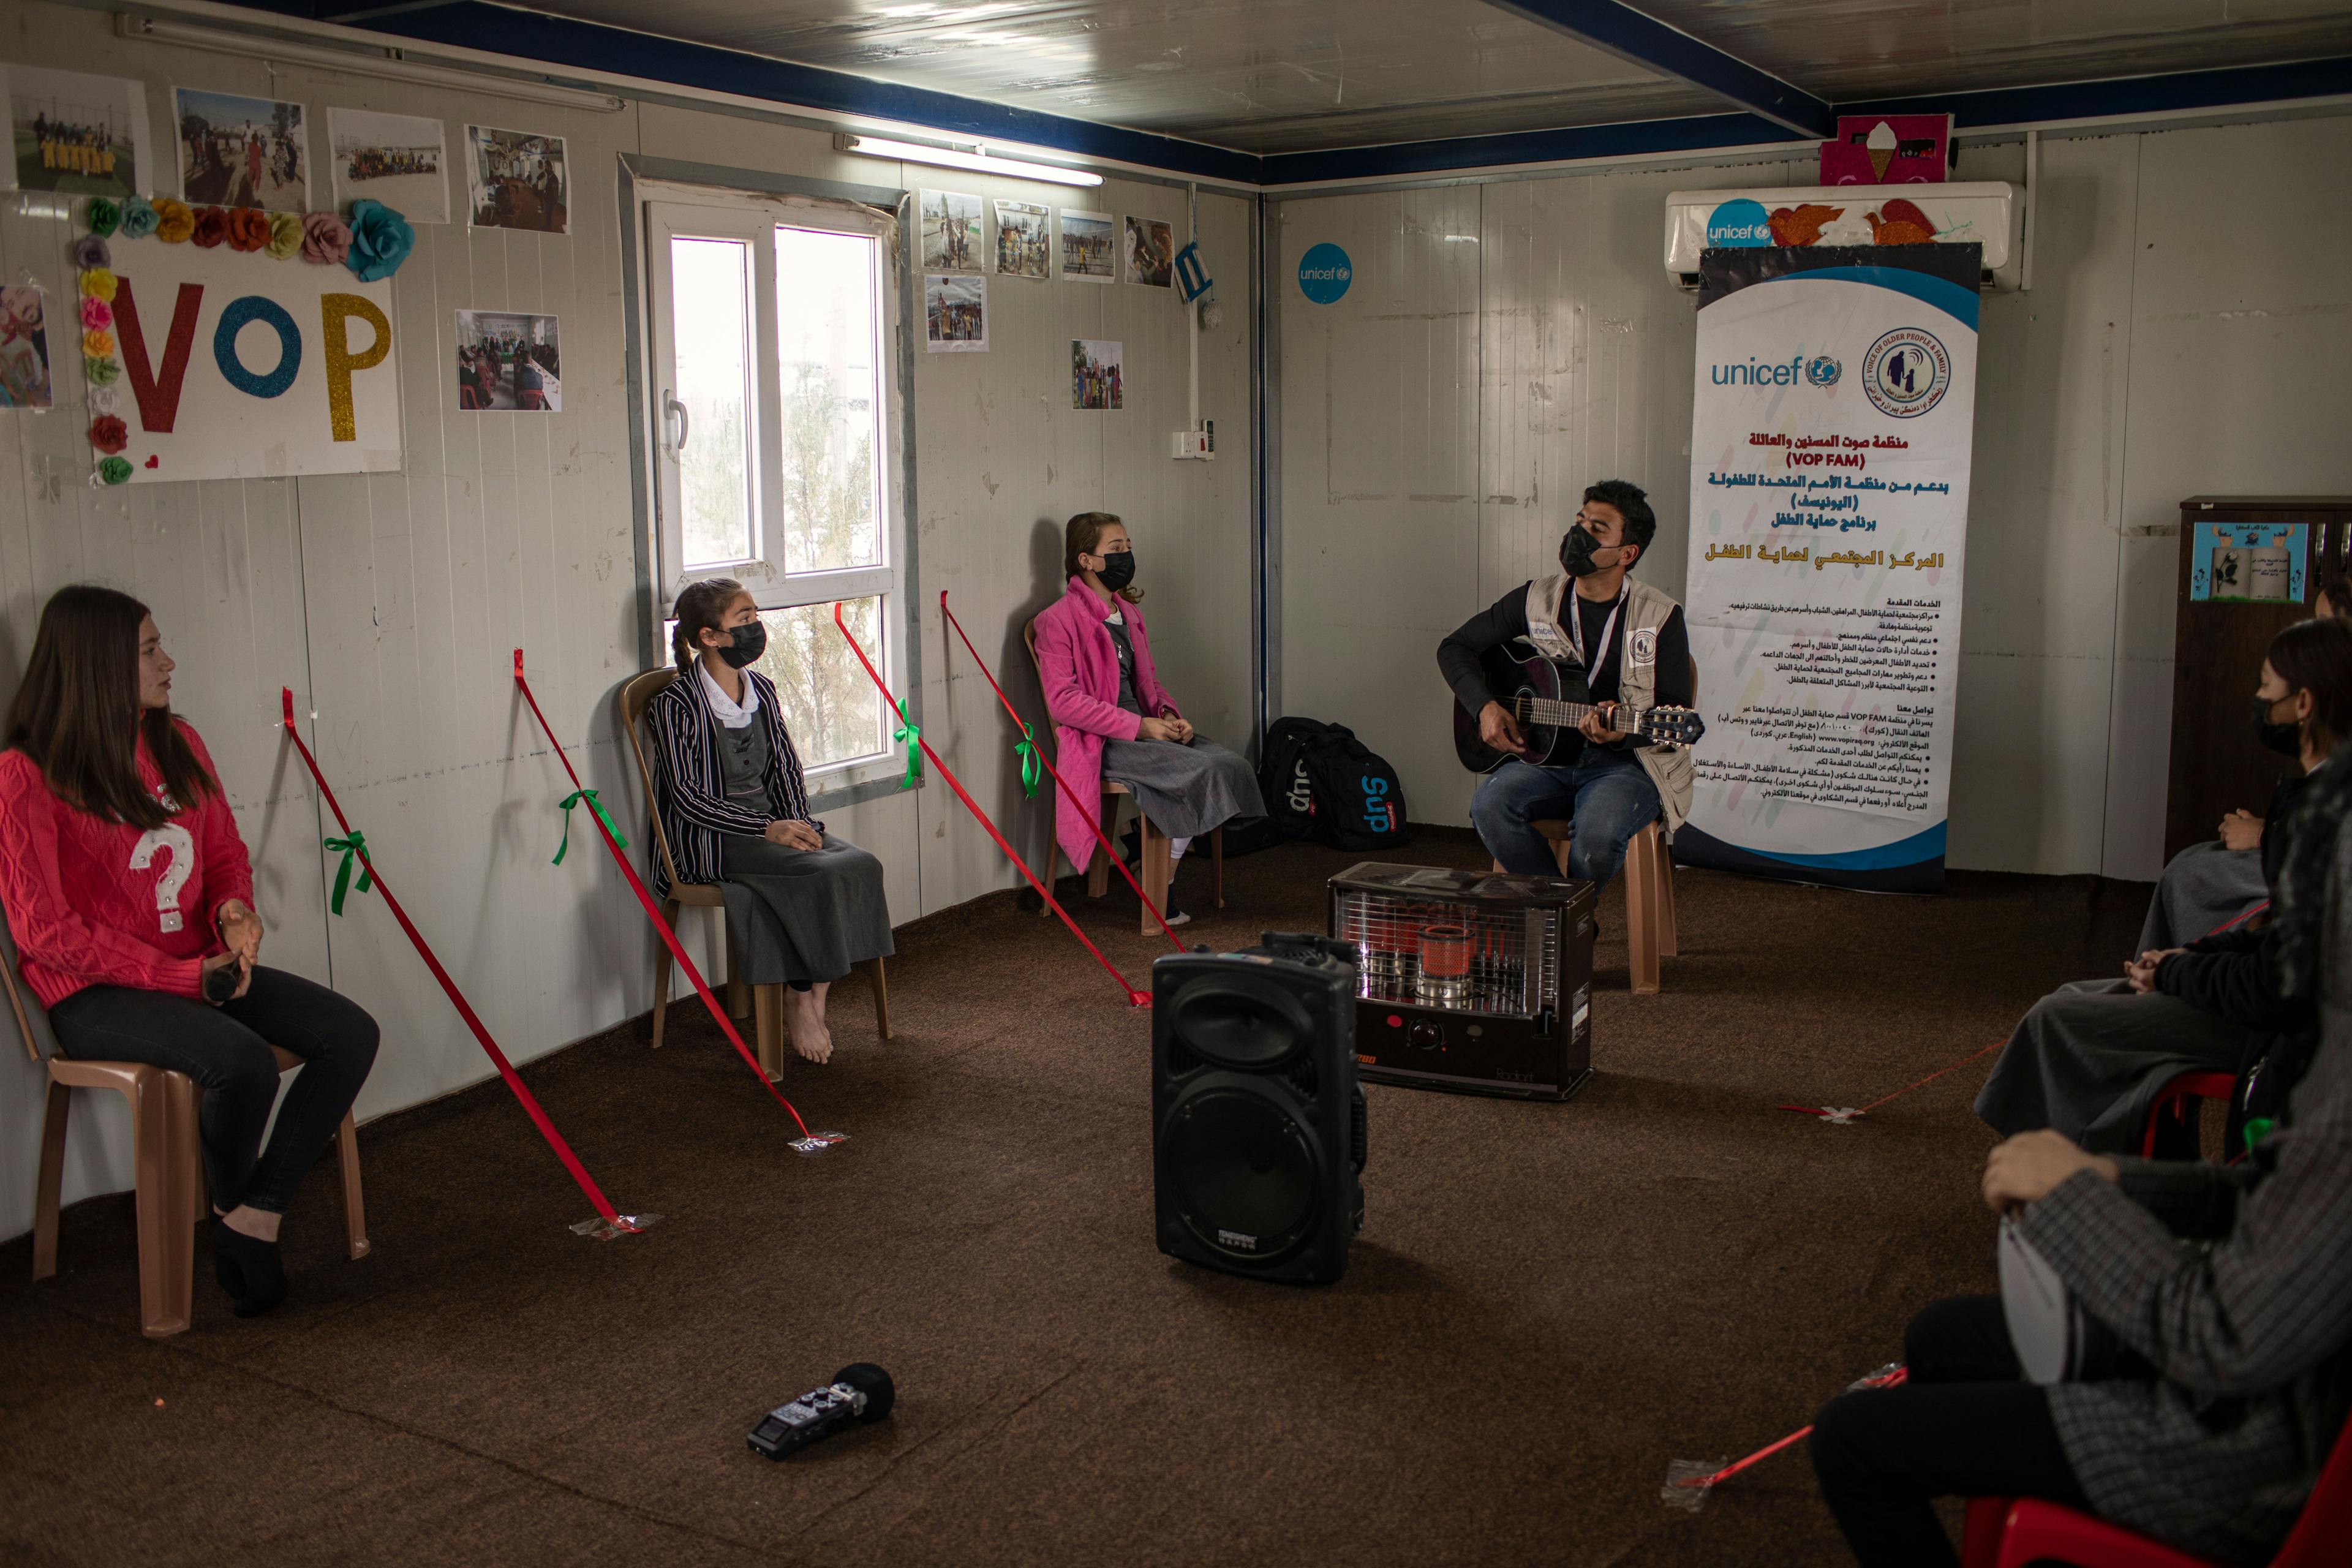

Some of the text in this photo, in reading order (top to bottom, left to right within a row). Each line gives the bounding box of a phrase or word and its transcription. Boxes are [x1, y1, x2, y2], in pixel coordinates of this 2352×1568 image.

[1709, 224, 1753, 239] unicef
[1300, 266, 1335, 280] unicef
[113, 276, 392, 442] VOP
[1866, 333, 1947, 374] VOICE OF OLDER PEOPLE FAMILY
[1712, 356, 1802, 385] unicef
[1749, 433, 1908, 450] منظمة صوت المسنين والعائلة
[1786, 451, 1865, 470] (VOP FAM)
[1708, 472, 1948, 496] بدعم من منظمة الأمم المتحدة للطفولة
[1771, 513, 1876, 532] برنامج حماية الطفل
[1705, 544, 1943, 570] المركز المجتمعي لحماية الطفل
[1869, 714, 1887, 722] FAM
[1819, 736, 1874, 747] www.vopiraq.org
[1361, 775, 1390, 833] Sup
